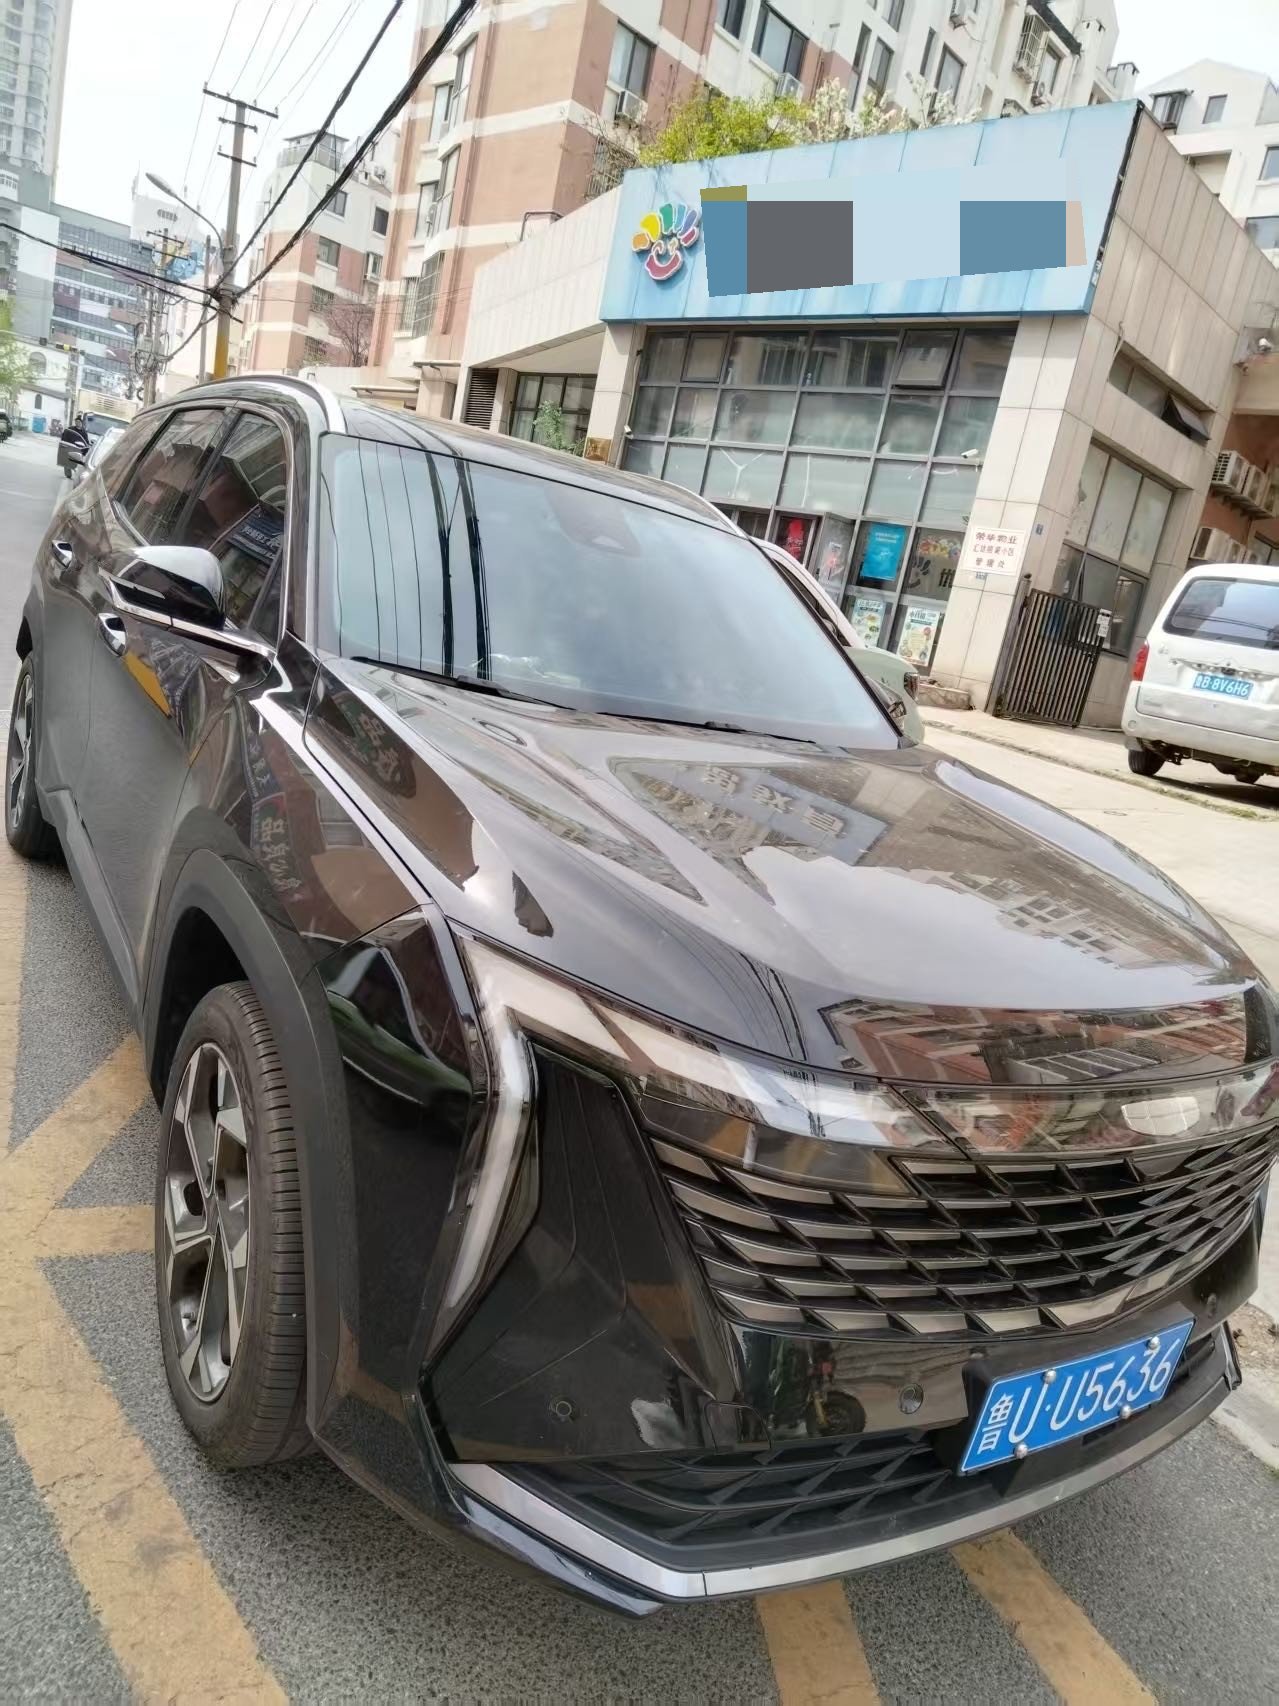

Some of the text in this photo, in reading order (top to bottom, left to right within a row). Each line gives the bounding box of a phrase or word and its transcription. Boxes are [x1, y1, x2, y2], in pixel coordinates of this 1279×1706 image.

[975, 532, 1018, 545] 荣华物业
[976, 1338, 1181, 1455] 鲁U·U5636
